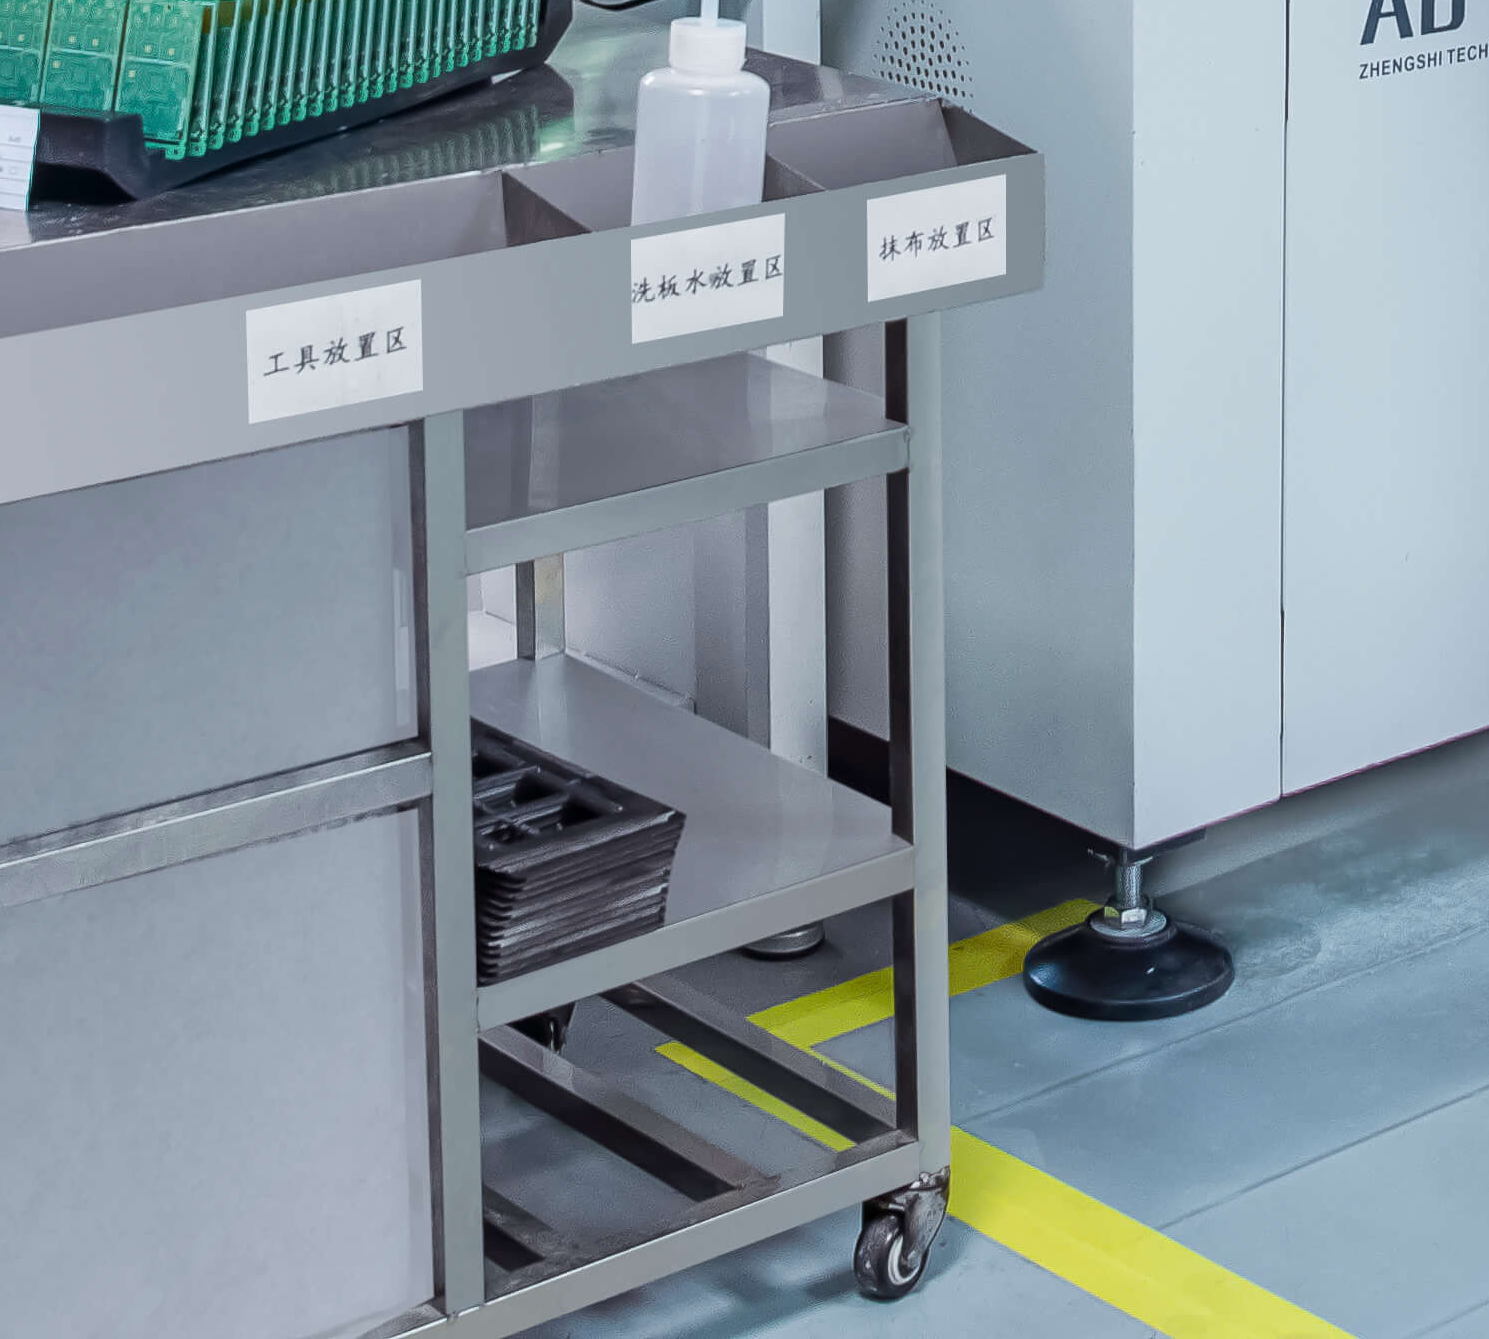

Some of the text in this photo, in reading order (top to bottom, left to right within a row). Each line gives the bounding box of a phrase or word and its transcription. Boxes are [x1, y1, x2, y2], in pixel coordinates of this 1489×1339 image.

[1359, 50, 1443, 80] ZHENGSHI
[878, 217, 994, 261] 抹布放置区
[631, 254, 783, 303] 洗板水放置区
[263, 326, 408, 377] 工具放置区
